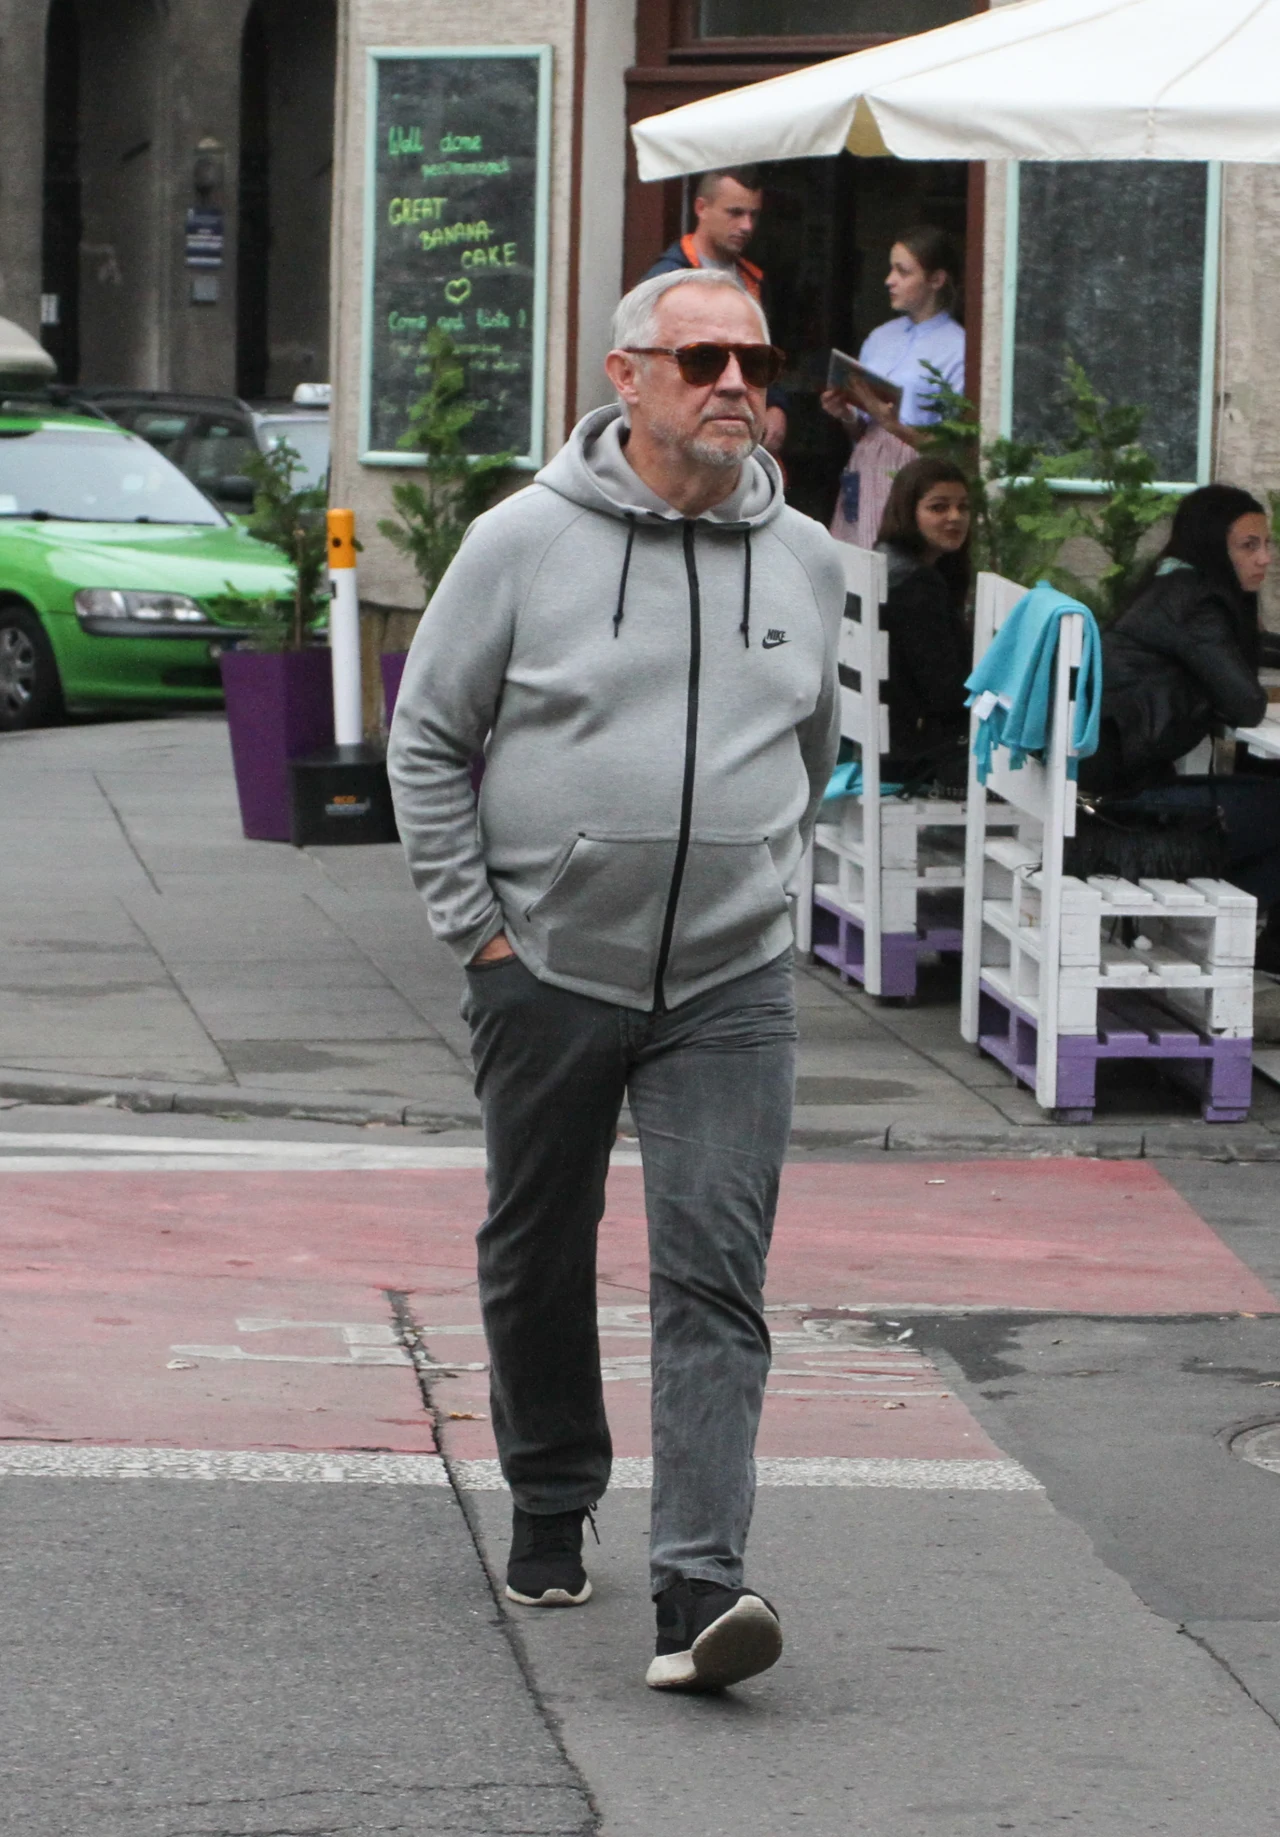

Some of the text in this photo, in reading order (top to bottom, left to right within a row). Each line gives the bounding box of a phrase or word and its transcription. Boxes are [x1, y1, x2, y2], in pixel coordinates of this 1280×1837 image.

[388, 196, 448, 226] GREAT
[419, 220, 495, 250] BANANA
[461, 242, 517, 269] CAKE
[766, 628, 786, 641] NIKE
